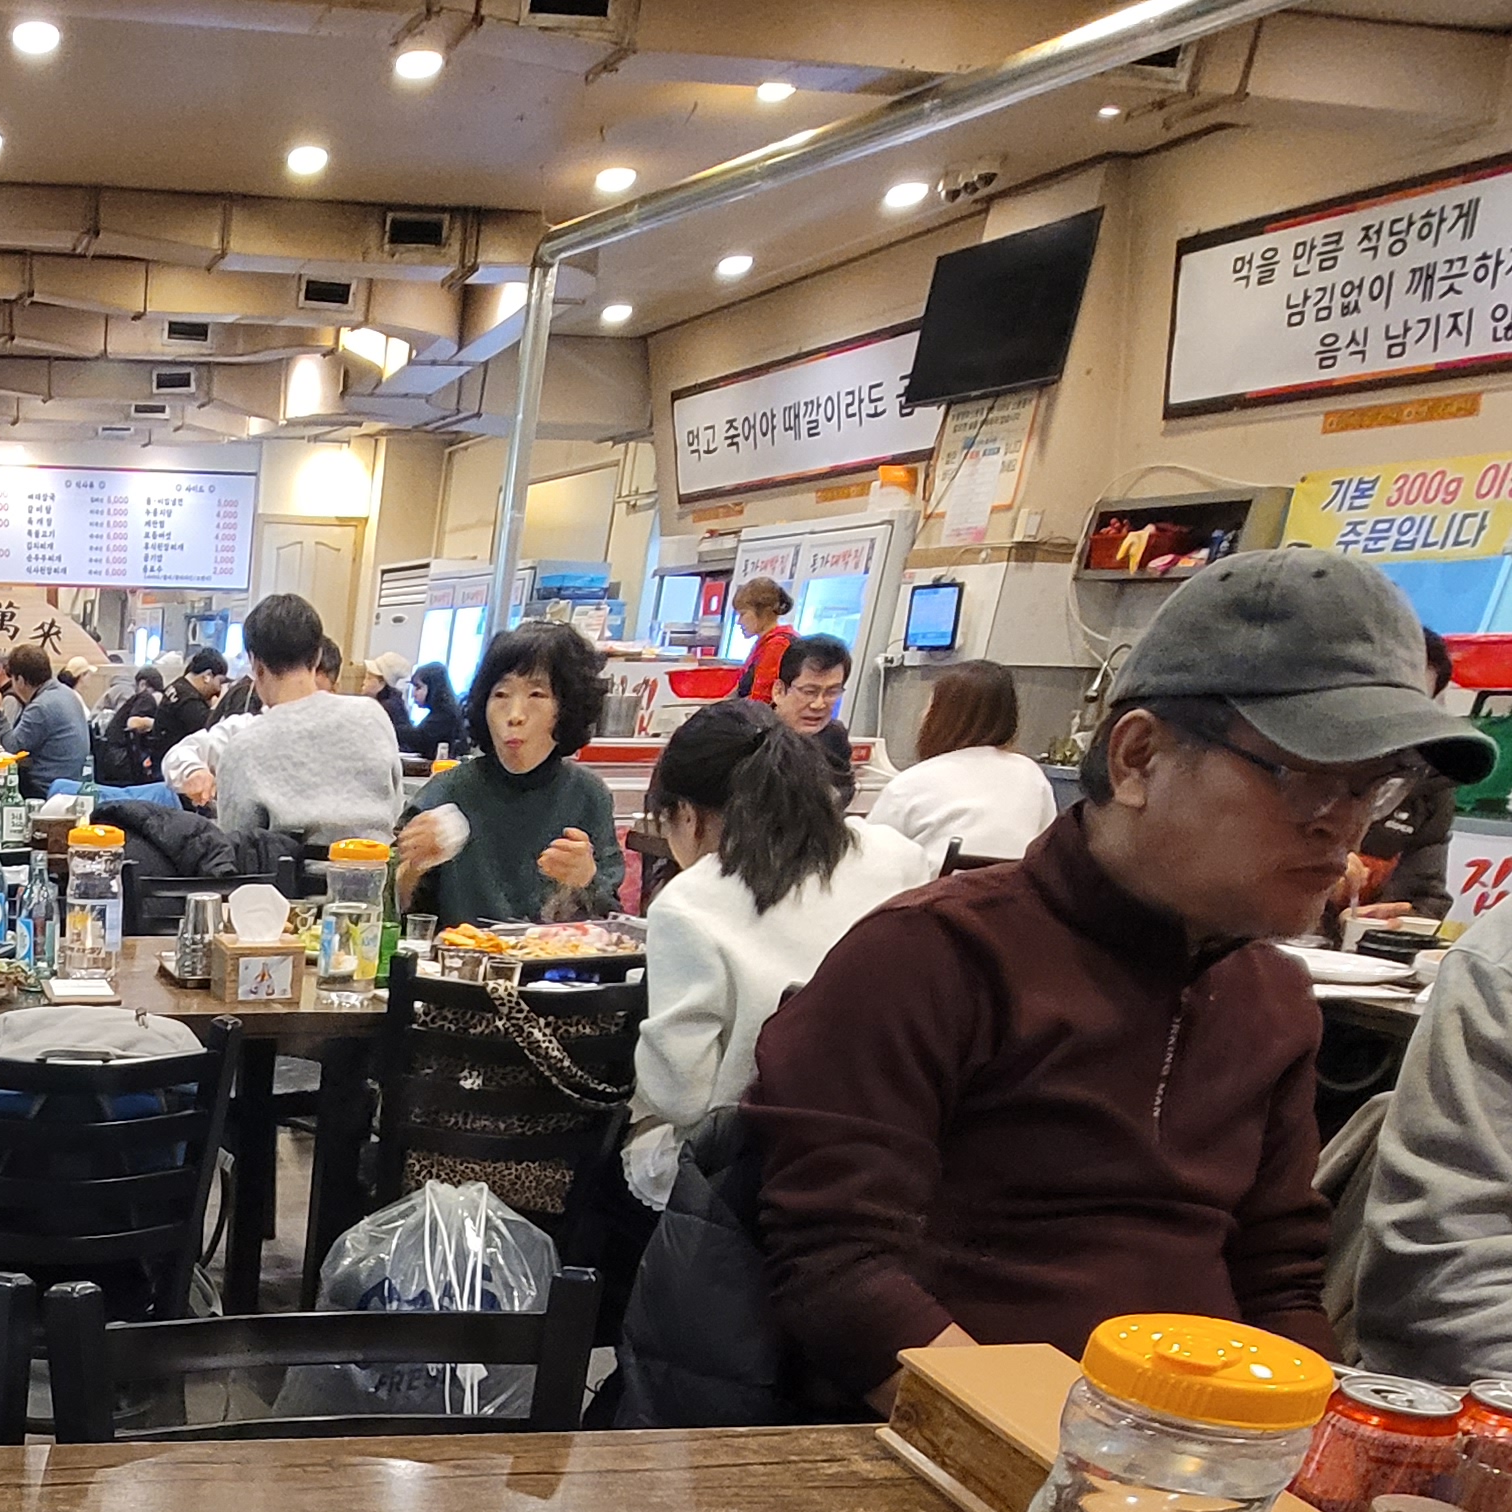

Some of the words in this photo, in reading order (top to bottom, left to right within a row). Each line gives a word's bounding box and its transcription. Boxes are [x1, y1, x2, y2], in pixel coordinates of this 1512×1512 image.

[1232, 246, 1280, 289] 먹을
[1292, 230, 1345, 278] 만큼
[1356, 196, 1481, 261] 적당하게
[1286, 270, 1395, 328] 남김없이
[1314, 326, 1370, 370] 음식
[1385, 307, 1475, 359] 남기지
[687, 424, 718, 462] 먹고
[724, 408, 778, 454] 죽어야
[782, 381, 887, 441] 때깔이라도
[1321, 474, 1381, 513] 기본
[1385, 469, 1464, 508] 300g
[1475, 461, 1512, 501] 이
[1335, 509, 1491, 555] 주문입니다
